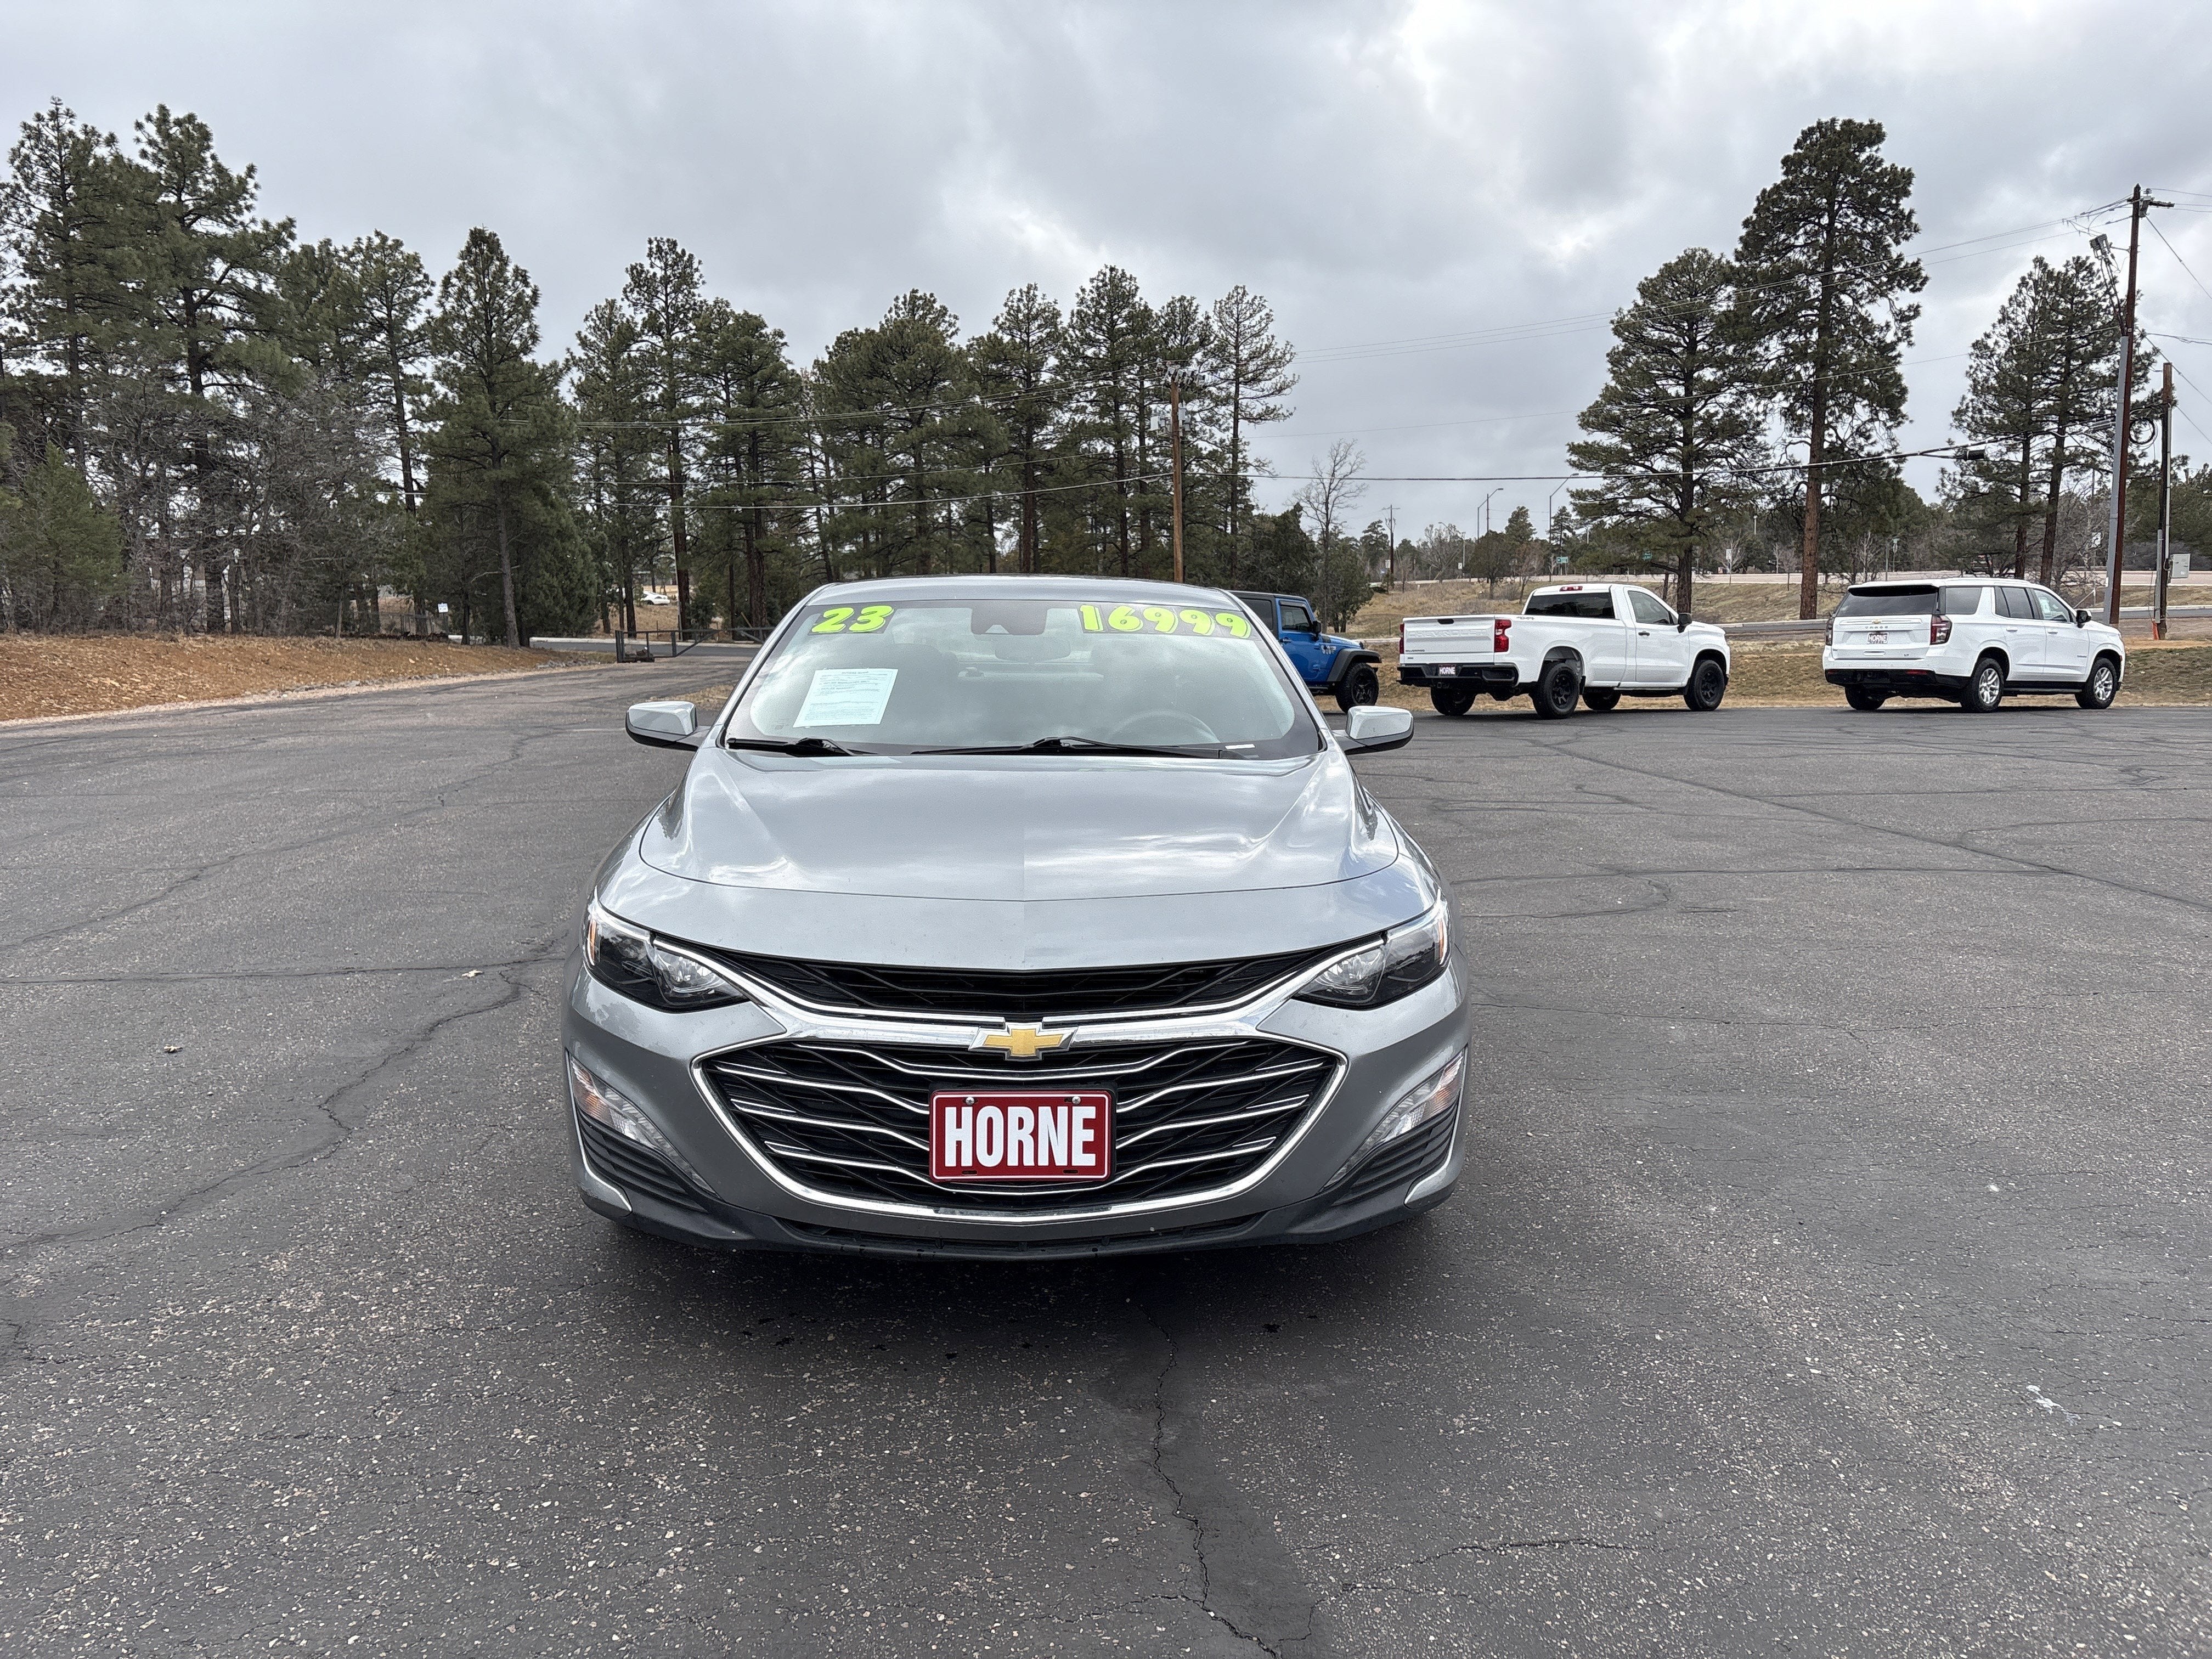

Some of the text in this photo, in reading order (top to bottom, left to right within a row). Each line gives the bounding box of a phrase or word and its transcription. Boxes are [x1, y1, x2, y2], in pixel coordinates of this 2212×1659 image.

[812, 606, 894, 633] 23
[1080, 605, 1251, 638] 16999
[1439, 667, 1455, 675] HORNE
[945, 1105, 1096, 1166] HORNE
